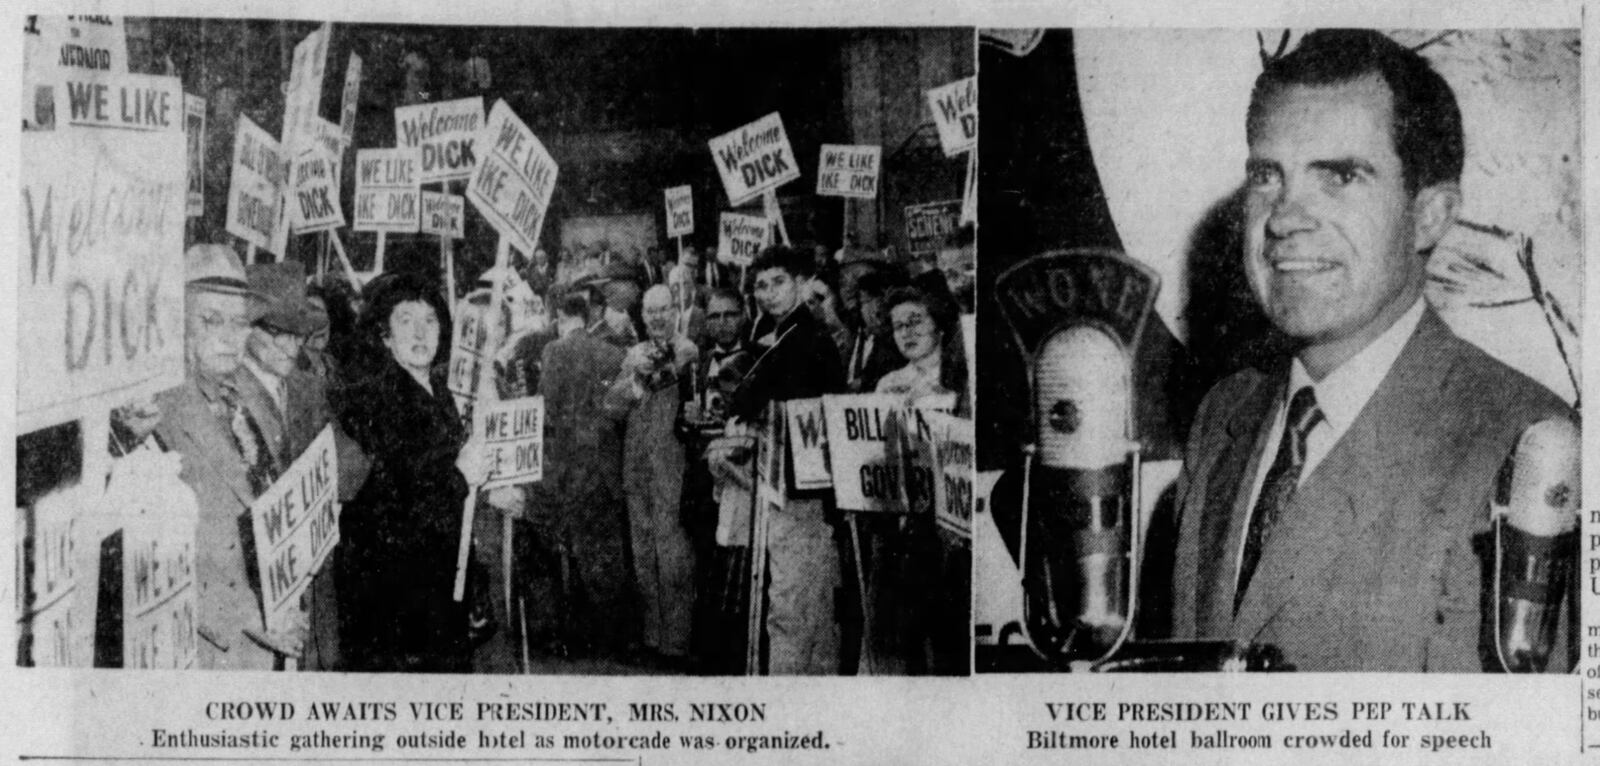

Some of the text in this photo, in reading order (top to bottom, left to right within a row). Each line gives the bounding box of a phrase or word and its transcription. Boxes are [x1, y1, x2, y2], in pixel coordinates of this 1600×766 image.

[67, 81, 171, 127] WE LIKE
[402, 107, 478, 147] Welcome
[422, 138, 476, 171] DICK
[498, 118, 551, 199] WE LIKE
[719, 126, 780, 173] Welcome
[825, 152, 874, 169] WE LIKE
[361, 159, 381, 184] WE
[385, 158, 414, 184] LIKE
[740, 148, 789, 188] DICK
[821, 172, 876, 192] IKE DICK
[298, 185, 335, 221] DICK
[358, 192, 417, 221] IKE DICK
[477, 155, 542, 242] IKE DICK
[673, 211, 691, 230] DICK
[723, 217, 765, 238] Welcome
[731, 237, 761, 257] DICK
[63, 266, 164, 372] DICK
[485, 408, 538, 439] WE LIKE
[844, 407, 888, 442] BILL
[516, 442, 540, 472] DICK
[263, 448, 330, 545] WE LIKE
[269, 498, 336, 602] IKE DICK
